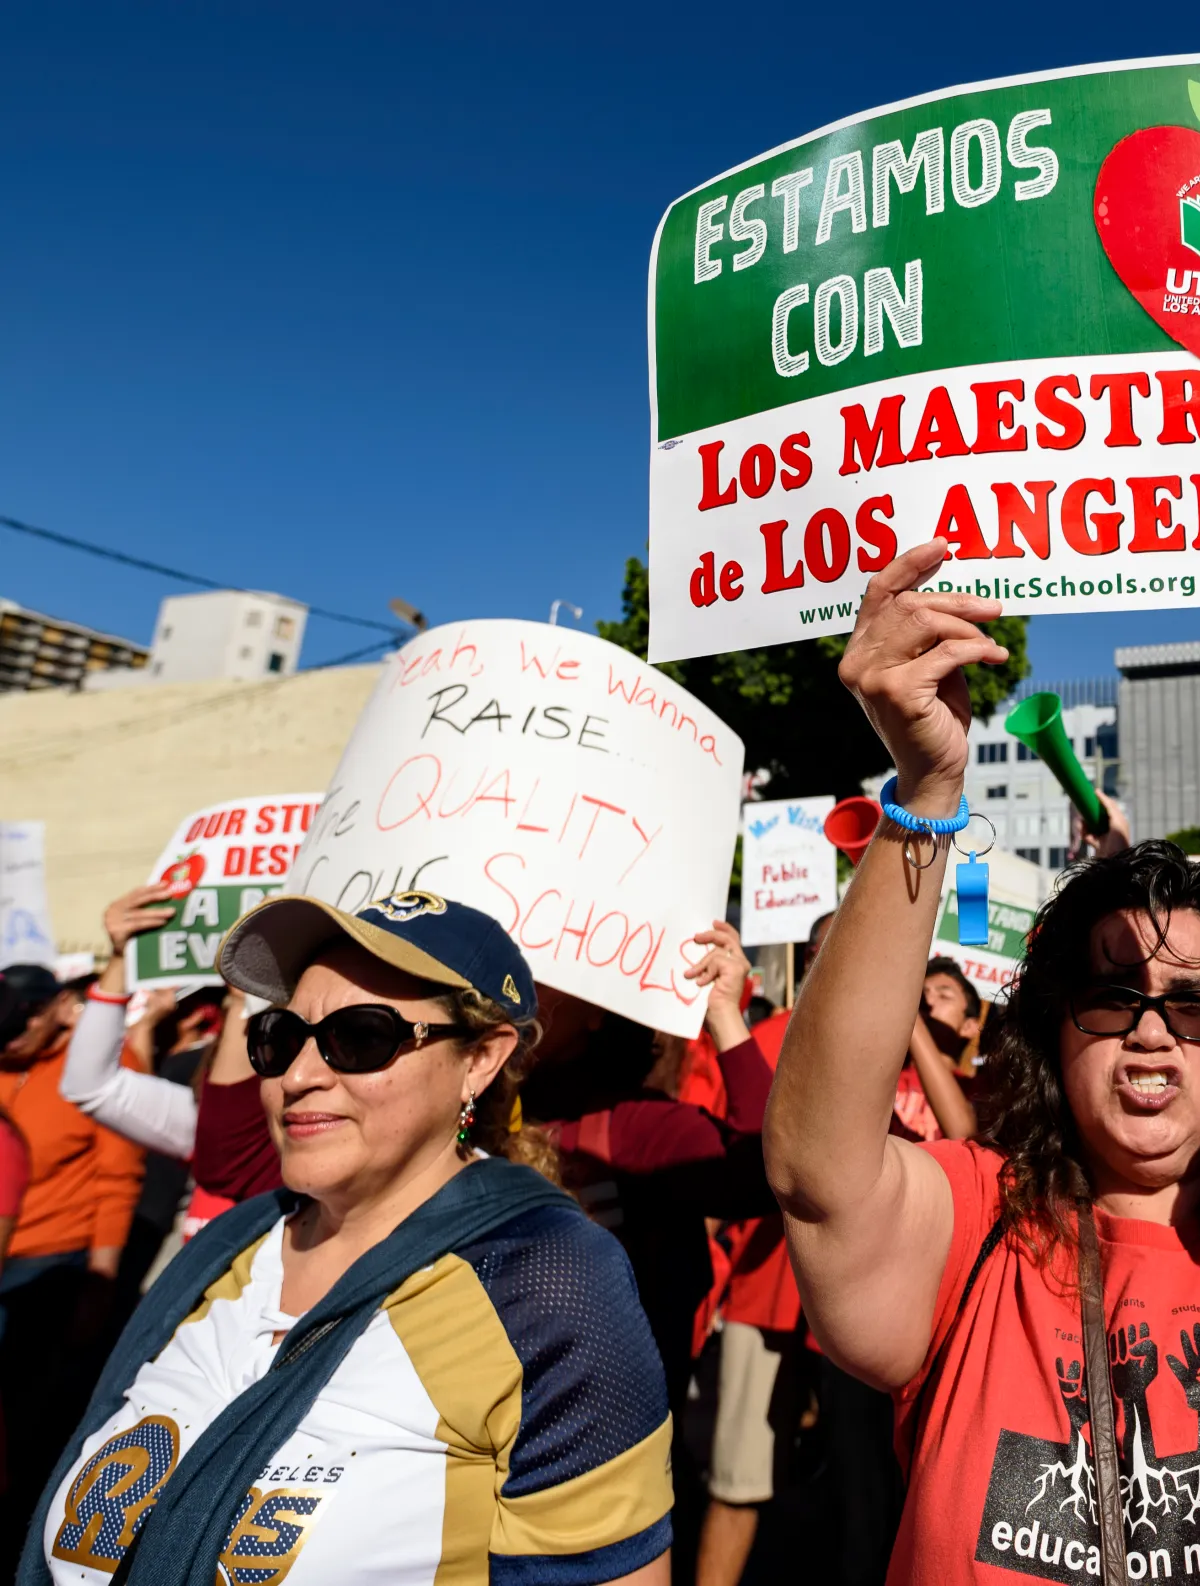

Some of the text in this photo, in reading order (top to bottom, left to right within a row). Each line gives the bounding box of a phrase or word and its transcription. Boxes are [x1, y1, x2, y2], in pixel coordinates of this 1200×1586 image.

[694, 108, 1060, 284] ESTAMOS
[771, 258, 924, 378] CON
[1162, 301, 1189, 314] LOS
[1163, 294, 1200, 305] UNITED
[689, 552, 744, 608] de
[759, 494, 899, 595] LOS
[520, 640, 582, 681] We
[184, 807, 249, 845] OUR
[375, 753, 664, 886] QUALITY
[222, 843, 301, 878] DES
[760, 860, 809, 885] Public
[180, 888, 220, 928] A
[484, 852, 706, 1007] SCHOOLS
[991, 1518, 1173, 1581] educaon
